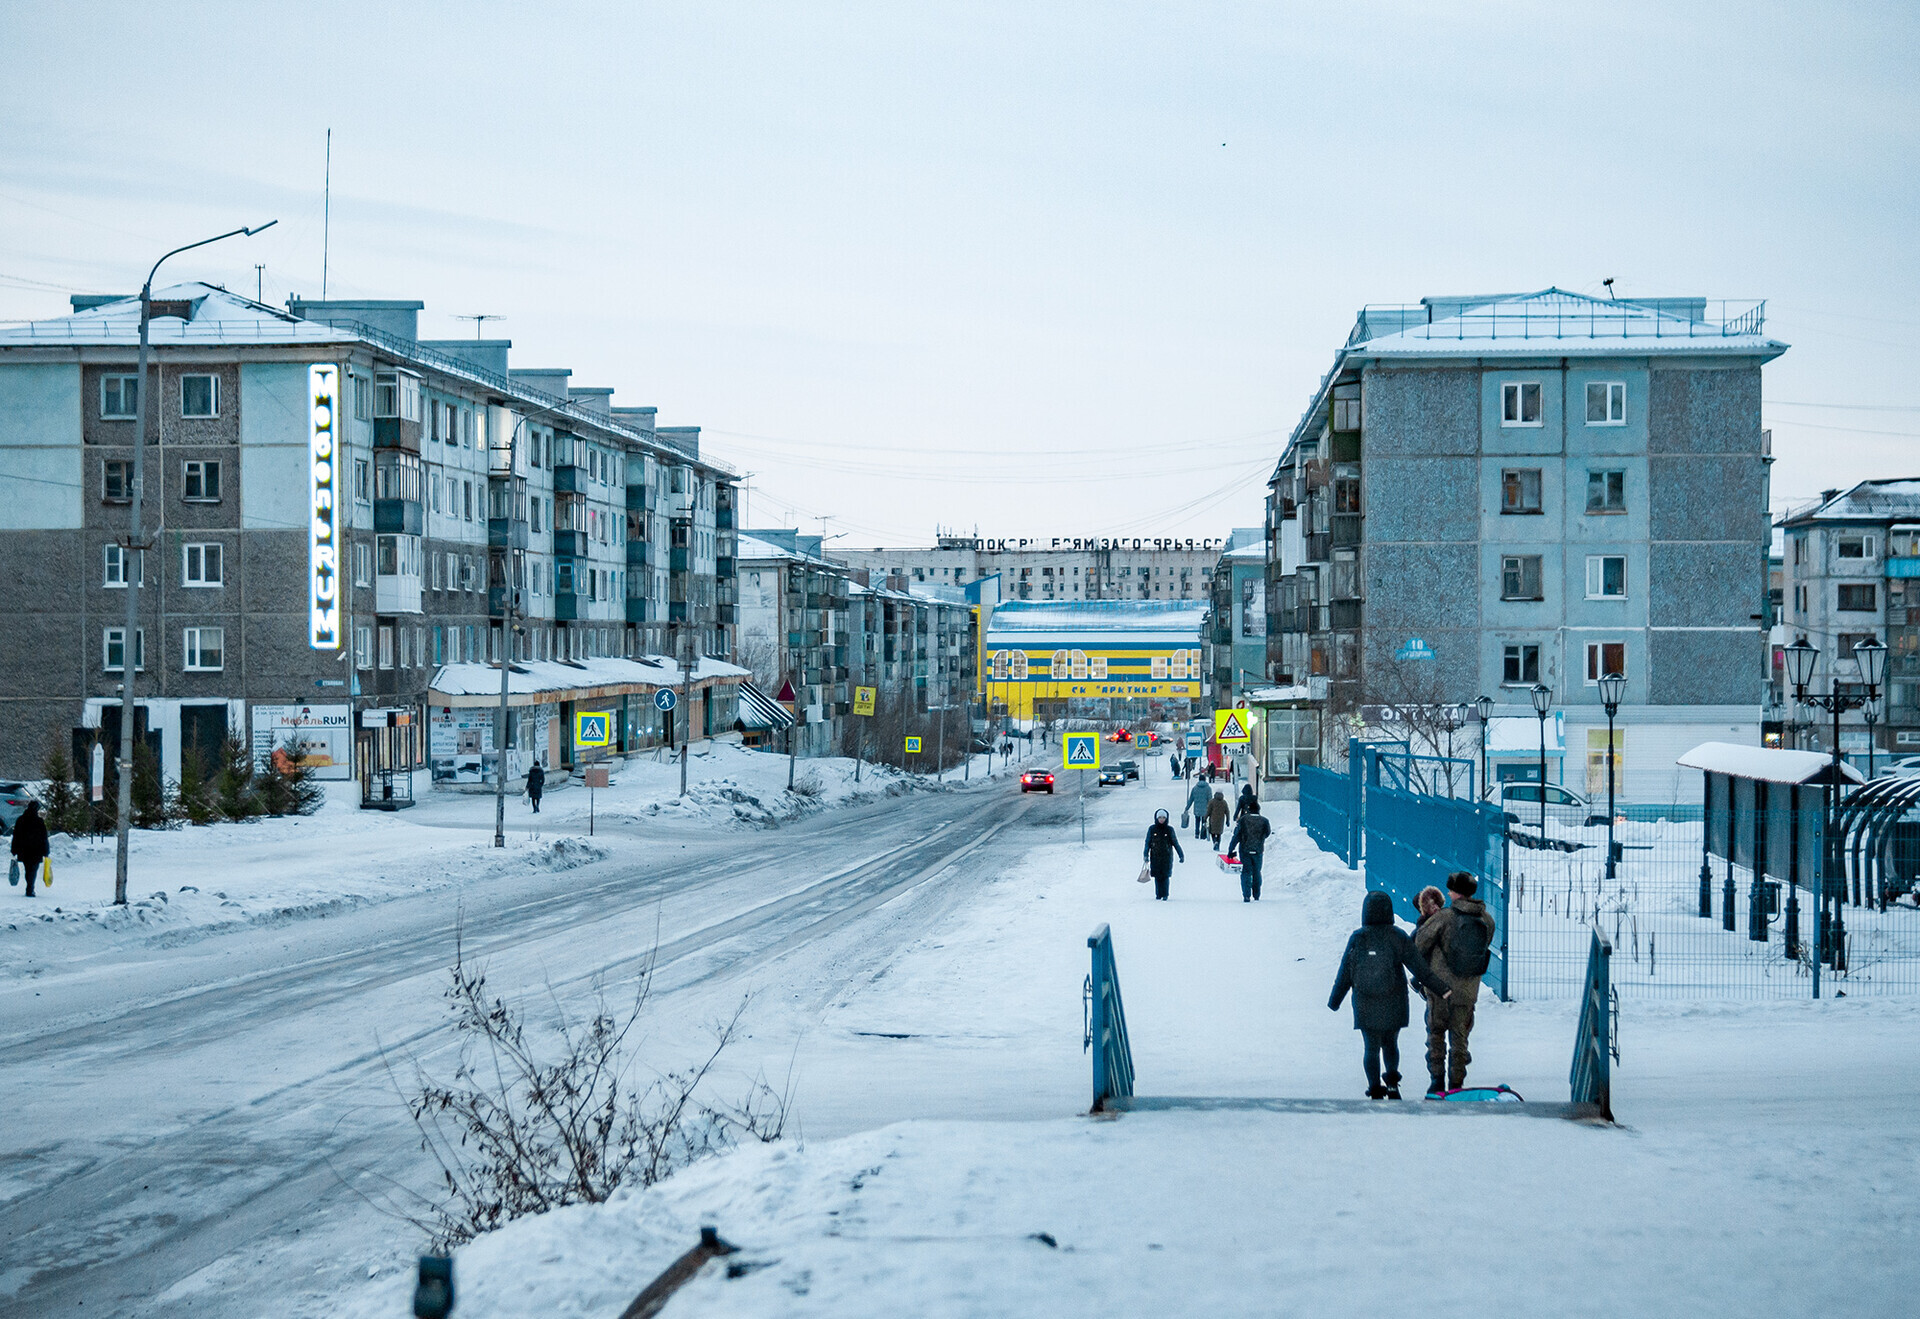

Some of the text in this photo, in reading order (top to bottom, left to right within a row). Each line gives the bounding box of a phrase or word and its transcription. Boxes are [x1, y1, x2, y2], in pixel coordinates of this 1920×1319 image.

[976, 538, 1094, 550] ПОКРЕЯМ
[1411, 639, 1424, 650] 10
[1071, 686, 1087, 694] СК
